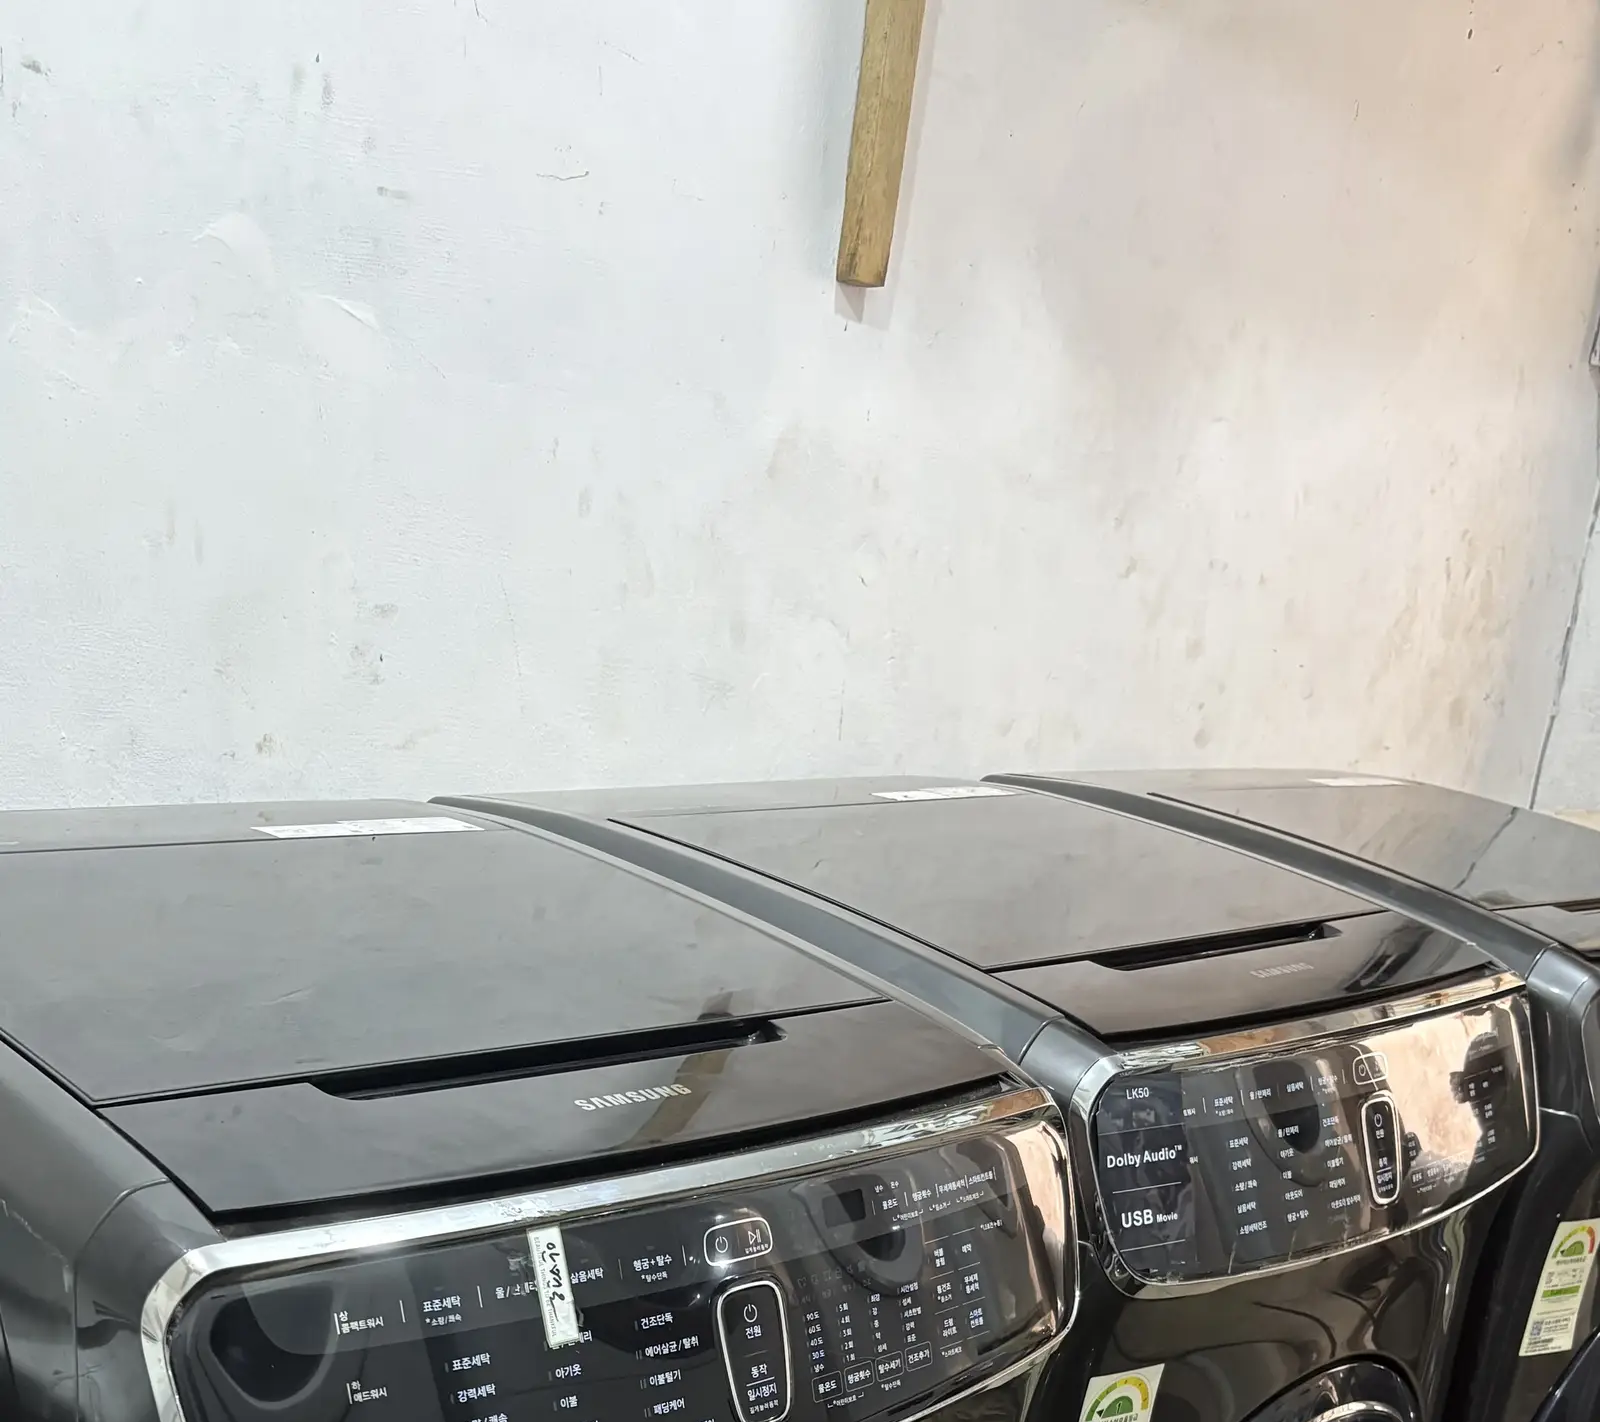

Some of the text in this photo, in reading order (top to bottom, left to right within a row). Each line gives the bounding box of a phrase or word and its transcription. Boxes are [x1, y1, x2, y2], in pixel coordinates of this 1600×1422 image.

[573, 1083, 692, 1111] SAMSUNG
[1126, 1087, 1150, 1100] LK50
[1107, 1152, 1141, 1168] Dolby
[1121, 1209, 1178, 1228] USB Movie
[570, 1267, 604, 1285] 삶음세탁
[423, 1295, 461, 1312] 표준세탁
[339, 1311, 348, 1321] 상
[641, 1312, 674, 1330] 건조단독
[745, 1324, 762, 1339] 전원
[452, 1352, 491, 1371] 표준세탁
[555, 1363, 582, 1379] 아기옷
[649, 1369, 682, 1386] 이불털기
[751, 1363, 768, 1378] 동작
[351, 1380, 361, 1390] 하
[457, 1383, 496, 1403] 강력세탁
[747, 1382, 778, 1401] 일시정지
[353, 1387, 388, 1402] 애드워시
[560, 1396, 578, 1409] 이불
[653, 1398, 686, 1415] 패딩케어
